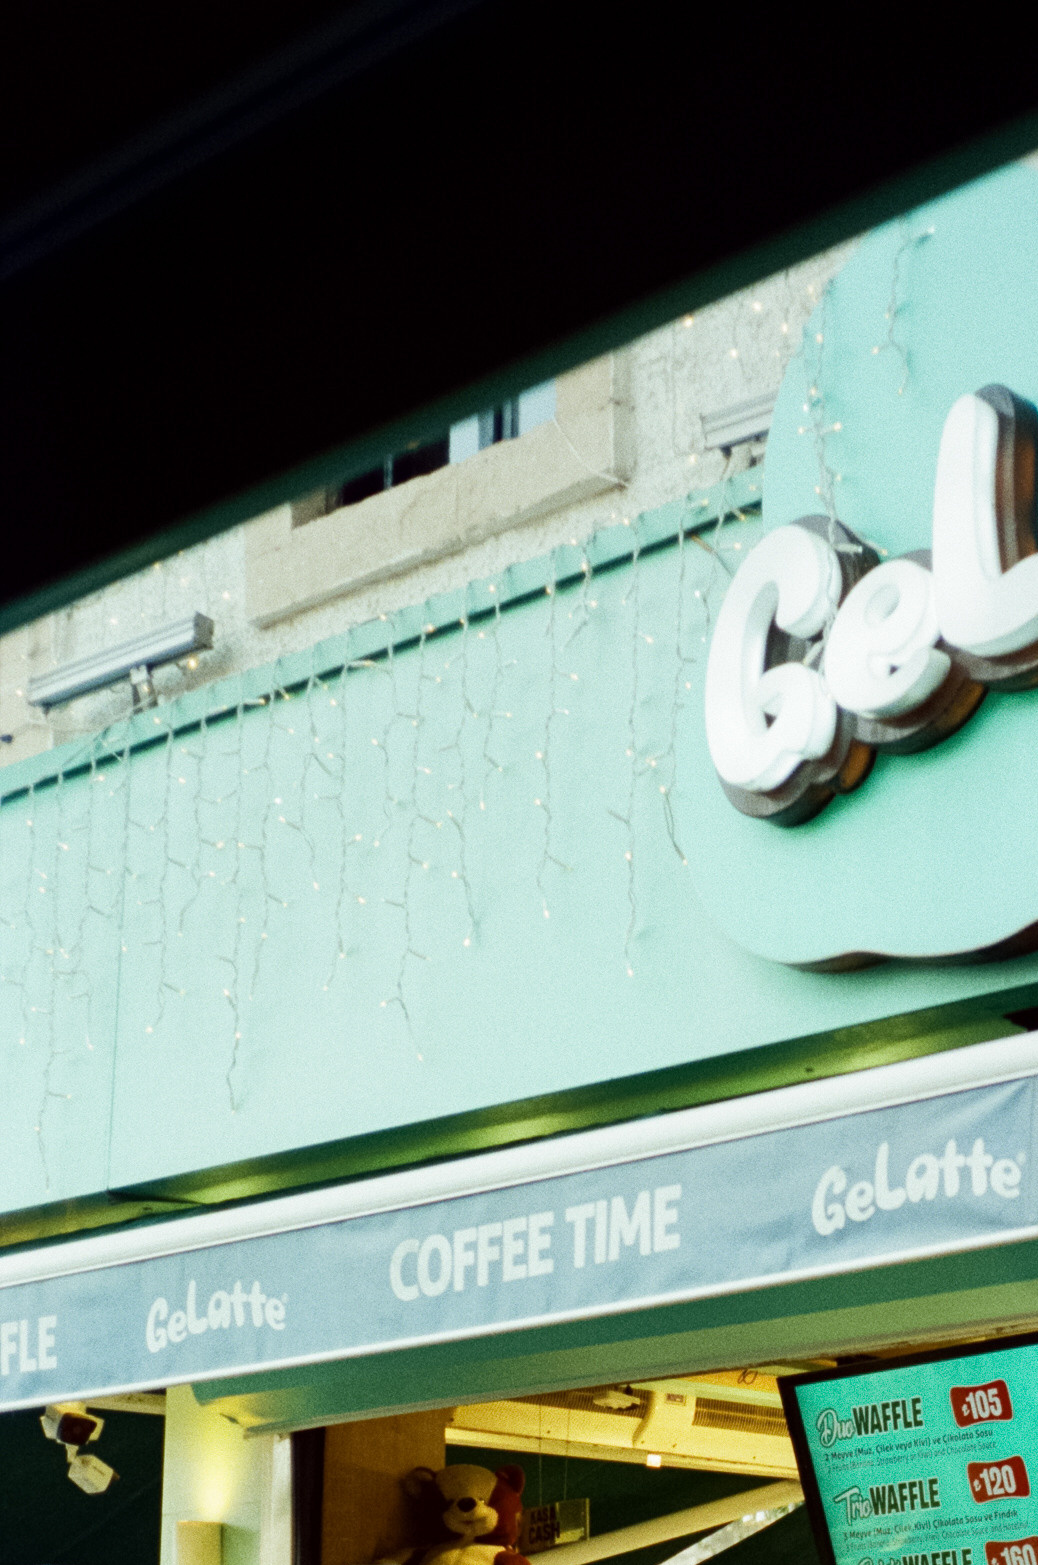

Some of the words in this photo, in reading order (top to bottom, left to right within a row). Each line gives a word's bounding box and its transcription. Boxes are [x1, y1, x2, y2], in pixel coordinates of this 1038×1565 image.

[811, 1138, 1022, 1236] GeLatte
[389, 1211, 554, 1301] COFFEE
[565, 1184, 683, 1269] TIME
[146, 1280, 287, 1353] GeLatte
[852, 1397, 924, 1436] WAFFLE
[870, 1477, 941, 1517] WAFFLE
